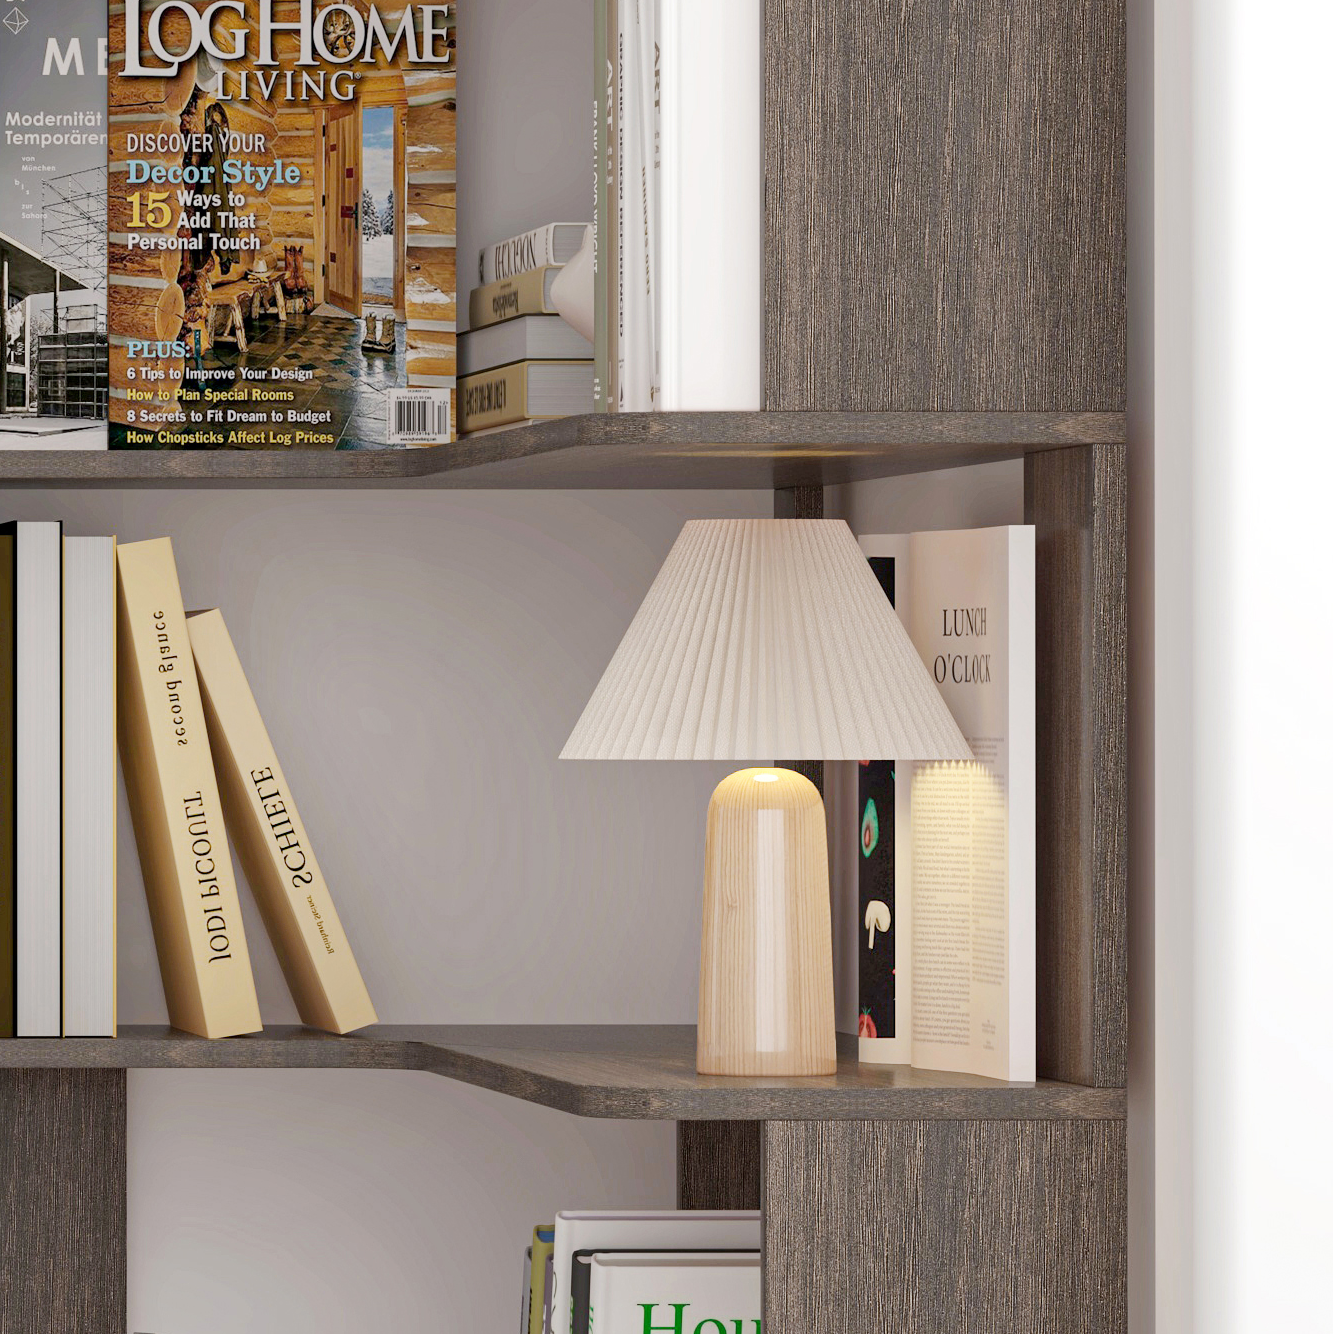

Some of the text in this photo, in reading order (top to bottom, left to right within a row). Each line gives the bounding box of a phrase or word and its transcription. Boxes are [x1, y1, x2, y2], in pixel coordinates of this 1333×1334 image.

[125, 158, 300, 191] Decor Style
[125, 190, 244, 228] 15 Ways to
[177, 210, 255, 228] Add That
[126, 232, 260, 249] Personal Touch
[126, 339, 190, 357] PLUS:
[126, 366, 312, 382] 6 Tips to Improve Your Design
[126, 387, 294, 403] How to Plan Special Rooms
[126, 408, 330, 424] 8 Secrets to Fit Dream to Budget
[126, 430, 333, 445] How Chopsticks Affect Log Prices
[942, 607, 986, 637] LUNCH
[934, 653, 991, 684] O'CLOCK
